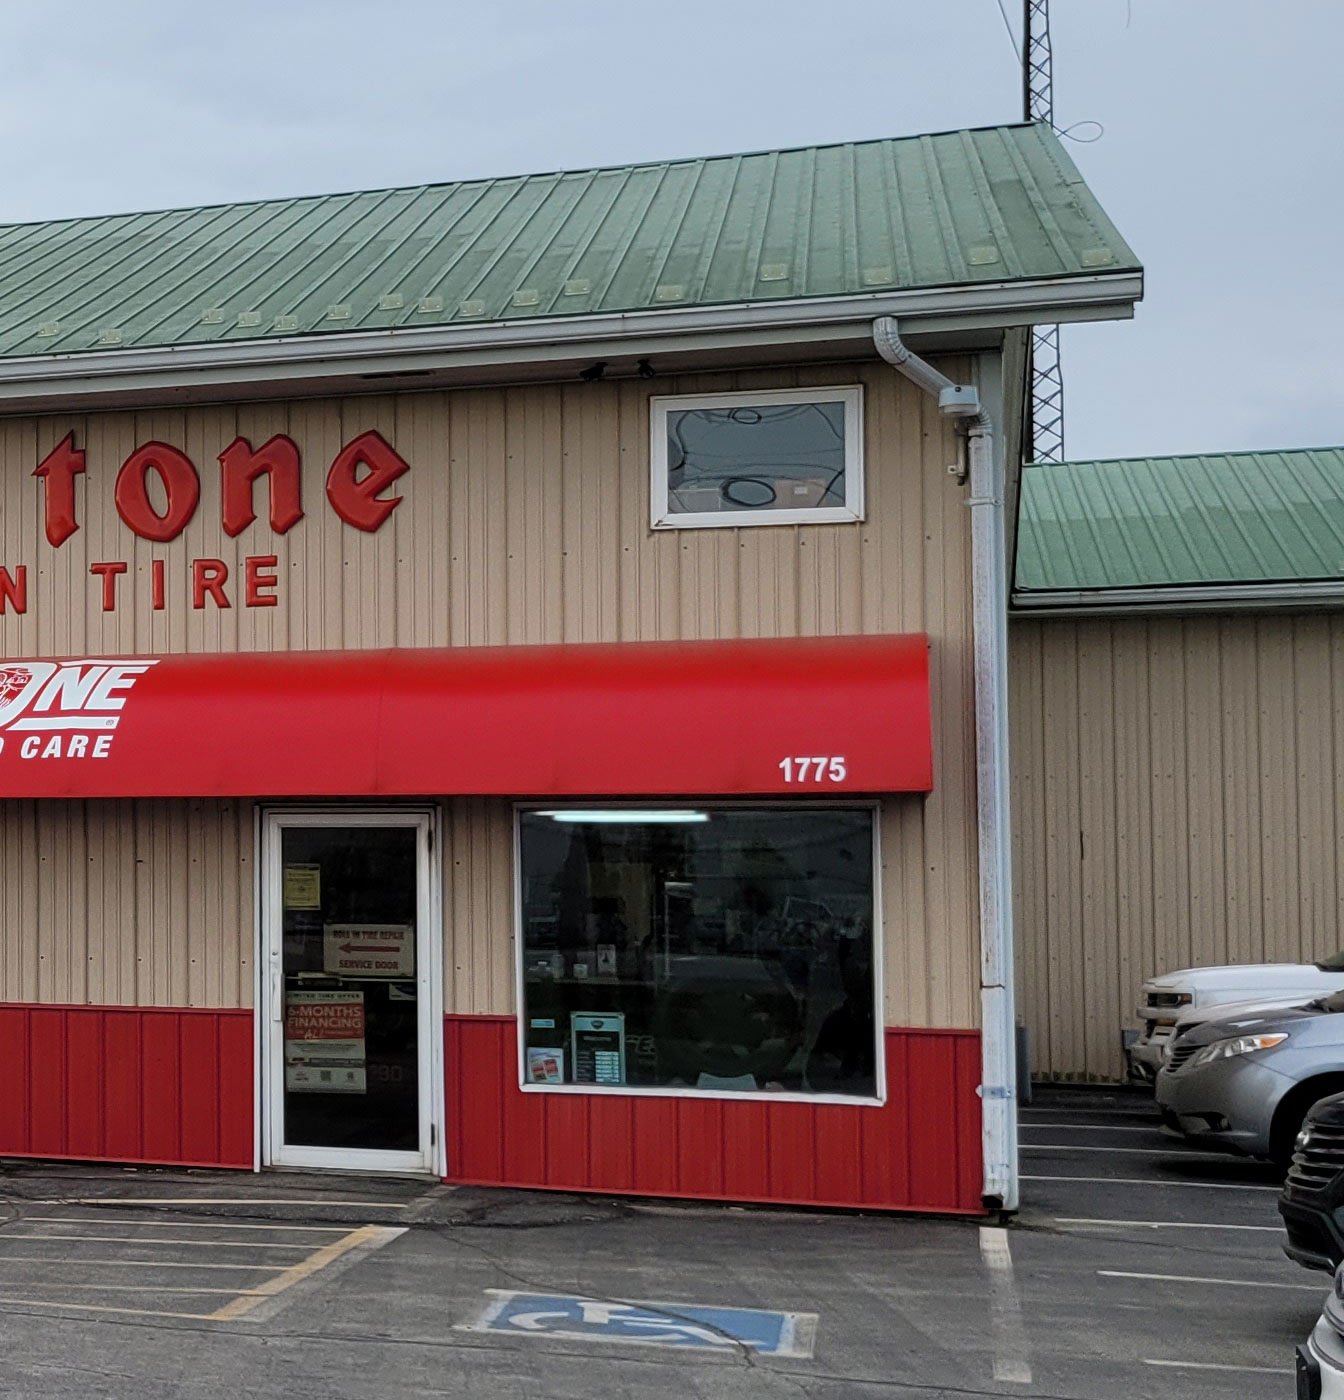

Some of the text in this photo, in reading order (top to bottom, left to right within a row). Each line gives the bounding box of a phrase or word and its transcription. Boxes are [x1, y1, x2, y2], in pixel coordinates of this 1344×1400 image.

[90, 555, 279, 613] TIRE
[20, 735, 114, 759] CARE
[779, 757, 846, 782] 1775
[339, 960, 399, 970] SERVICE DOOR
[288, 1006, 361, 1017] 6-MONTHS
[288, 1018, 362, 1028] FINANCING
